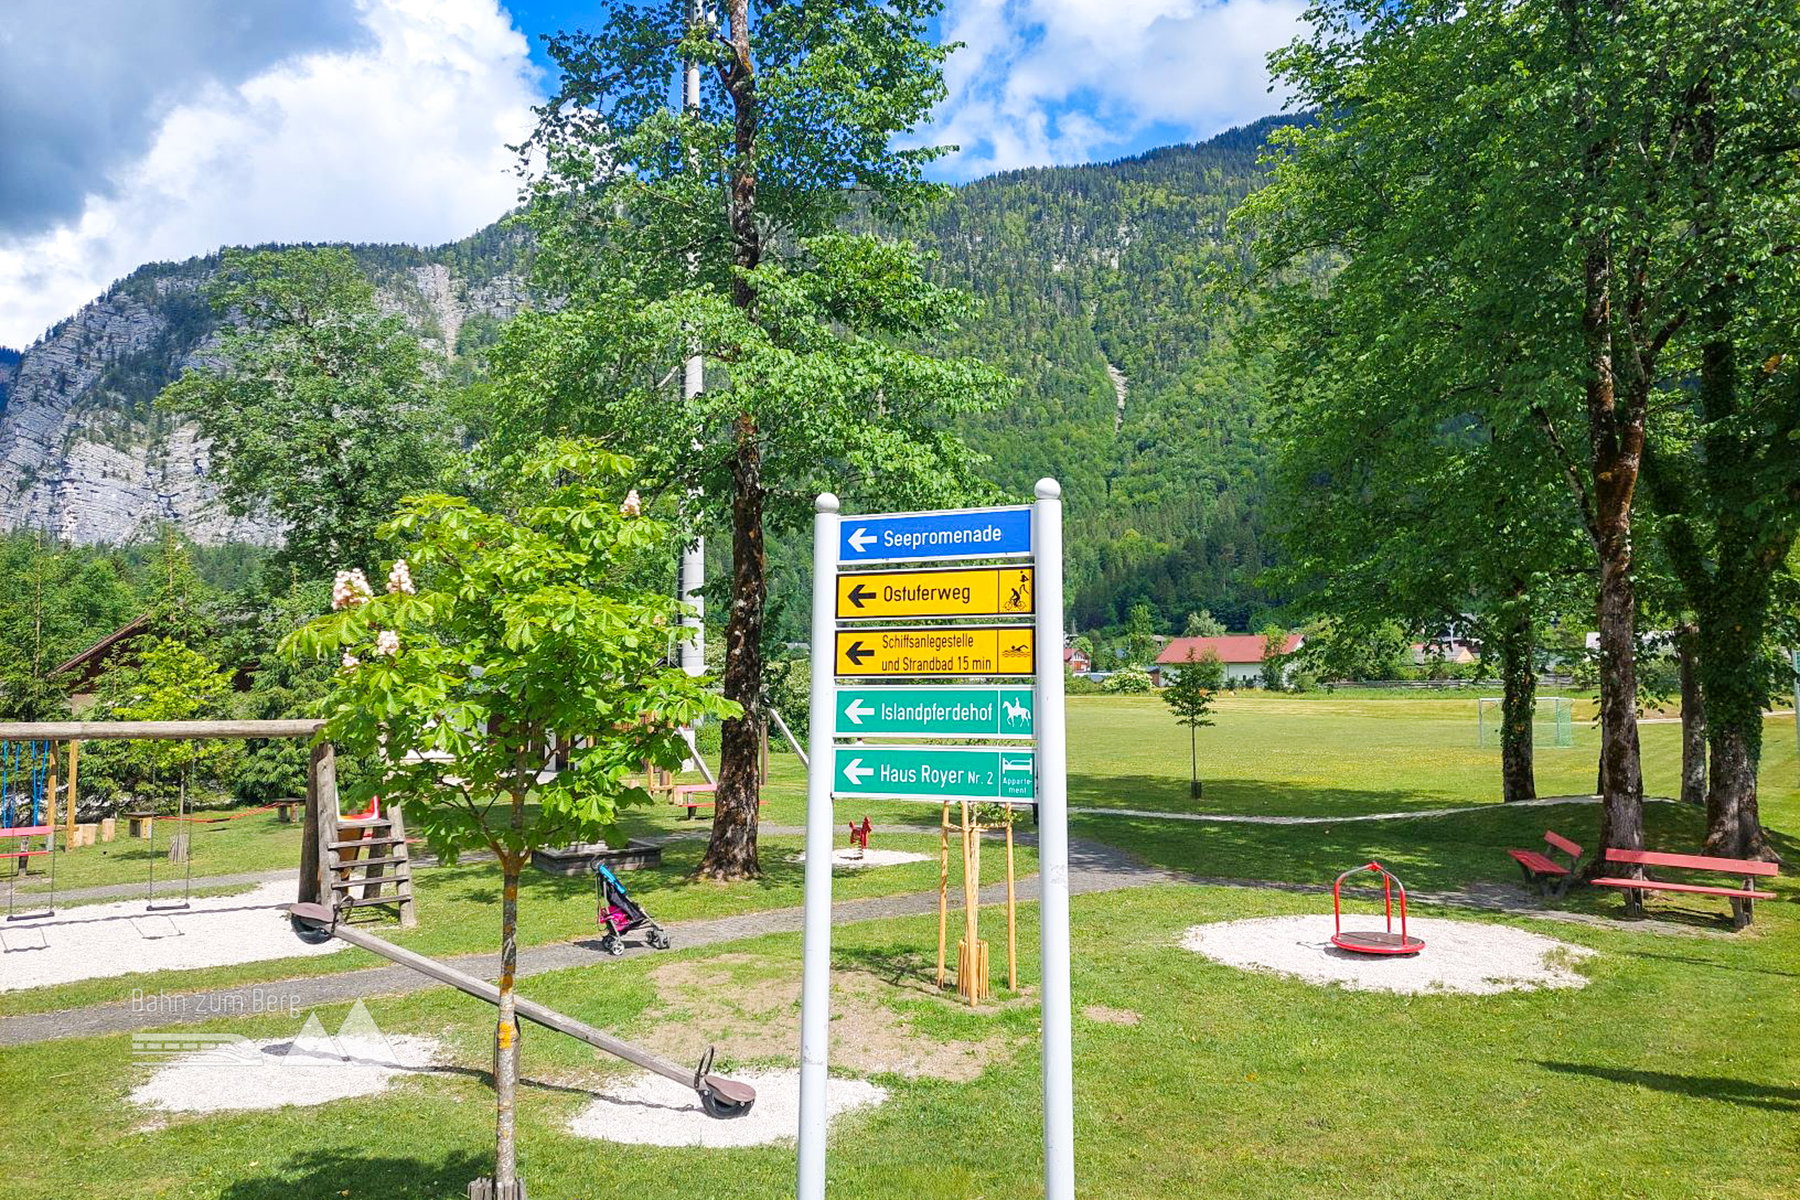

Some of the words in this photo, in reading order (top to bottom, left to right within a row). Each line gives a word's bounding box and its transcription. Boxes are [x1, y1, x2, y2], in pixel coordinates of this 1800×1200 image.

[883, 524, 1002, 549] Seepromenade
[883, 585, 971, 604] Ostuferweg
[882, 633, 974, 651] Schiffsanlegestelle
[881, 658, 900, 672] und
[902, 656, 953, 671] Strandbad
[958, 656, 970, 670] 15
[972, 656, 992, 671] min
[881, 703, 993, 725] Islandpferdehof
[880, 764, 917, 783] Haus
[921, 765, 965, 790] Royer
[967, 773, 984, 785] Nr.
[986, 771, 994, 785] 2
[1002, 777, 1032, 787] Apparte-
